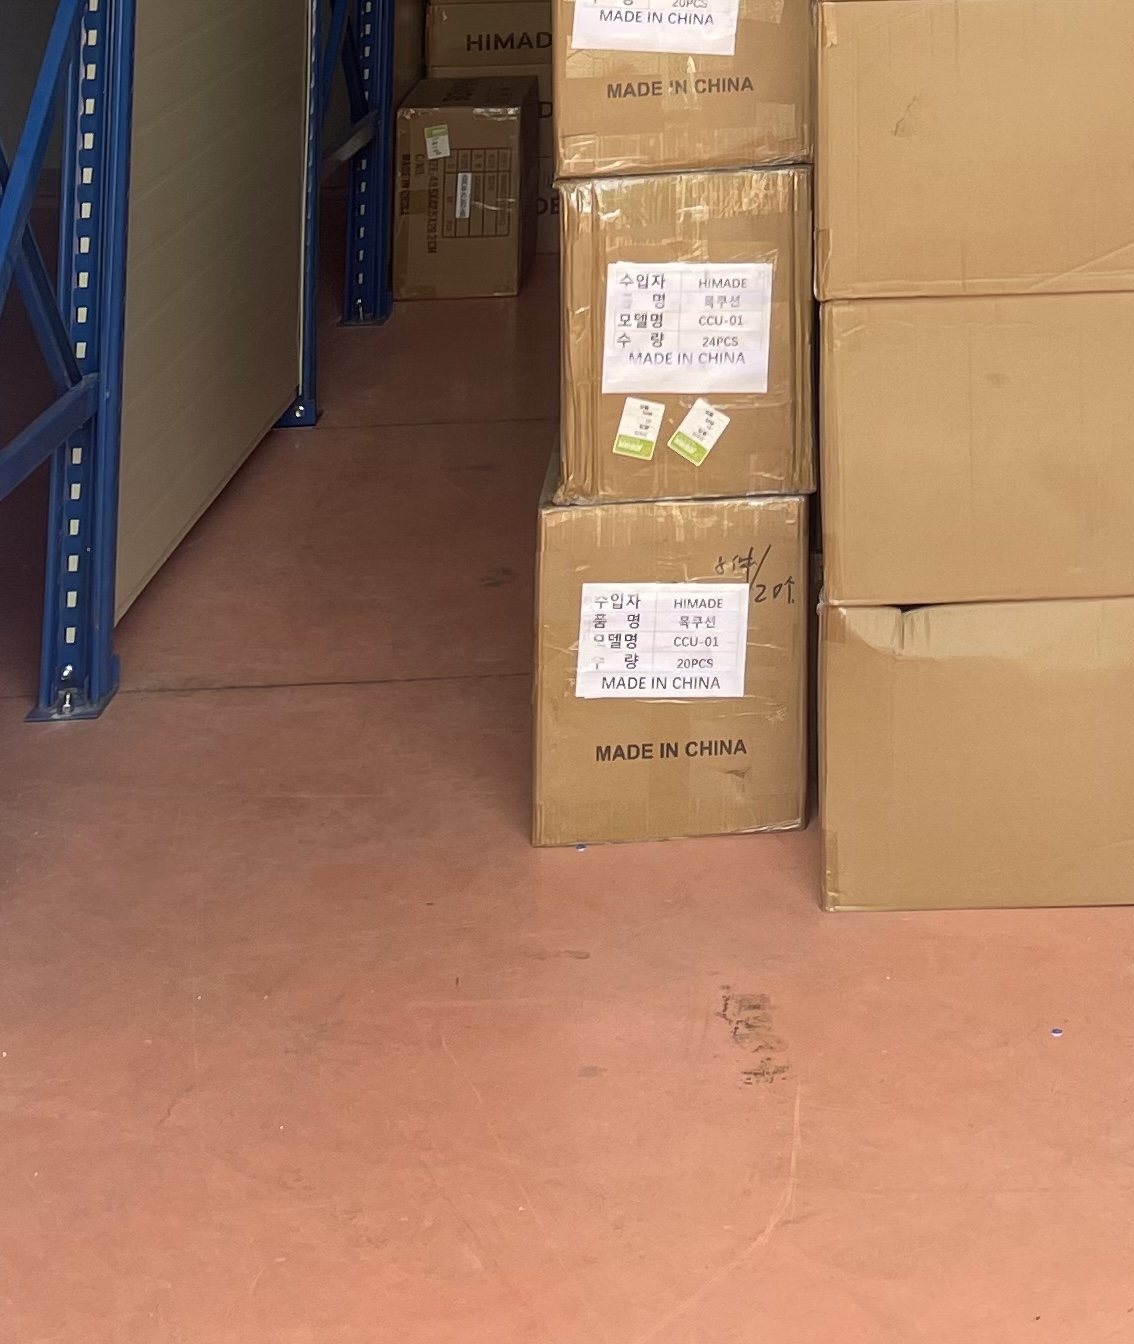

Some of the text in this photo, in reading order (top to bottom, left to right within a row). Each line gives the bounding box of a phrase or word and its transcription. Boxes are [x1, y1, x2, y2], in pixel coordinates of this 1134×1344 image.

[599, 9, 714, 26] MADE IN CHINA
[466, 31, 553, 52] HIMAD
[607, 80, 663, 99] MADE
[695, 76, 754, 94] CHINA
[619, 273, 748, 289] 수입자 HIMADE
[617, 313, 744, 329] 모델명 CCU-01
[616, 332, 631, 348] 수
[702, 336, 739, 348] 24PCS
[628, 352, 746, 366] MADE IN CHINA
[594, 593, 723, 610] 수입자 HIMADE
[627, 613, 641, 629] 명
[673, 636, 719, 648] CCU-01
[624, 653, 640, 670] 량
[676, 658, 714, 669] 20PCS
[601, 677, 721, 690] MADE IN CHINA
[595, 739, 748, 762] MADE IN CHINA
